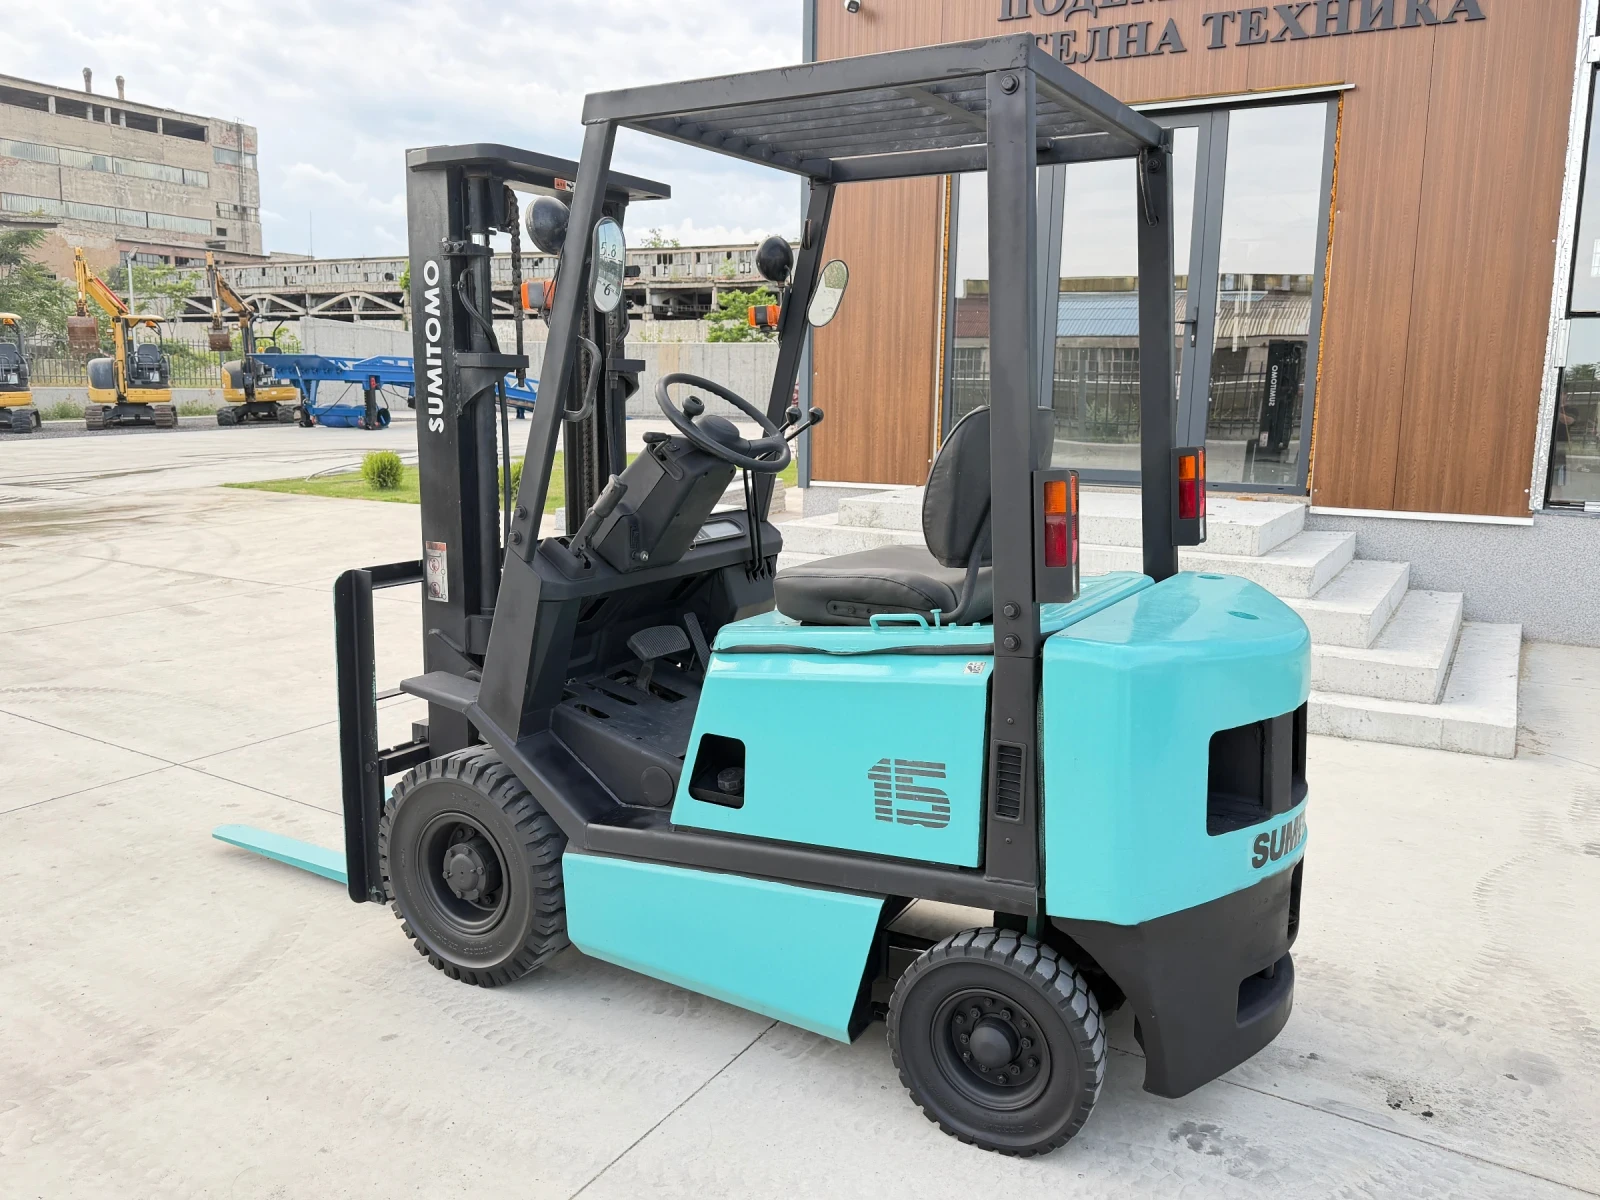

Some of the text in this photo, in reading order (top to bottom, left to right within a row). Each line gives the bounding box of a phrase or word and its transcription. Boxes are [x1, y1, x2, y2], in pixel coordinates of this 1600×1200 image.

[1034, 0, 1486, 65] ЕЛНА ТЕХНИКА
[423, 260, 445, 434] SUMITOMO
[867, 758, 951, 829] 15
